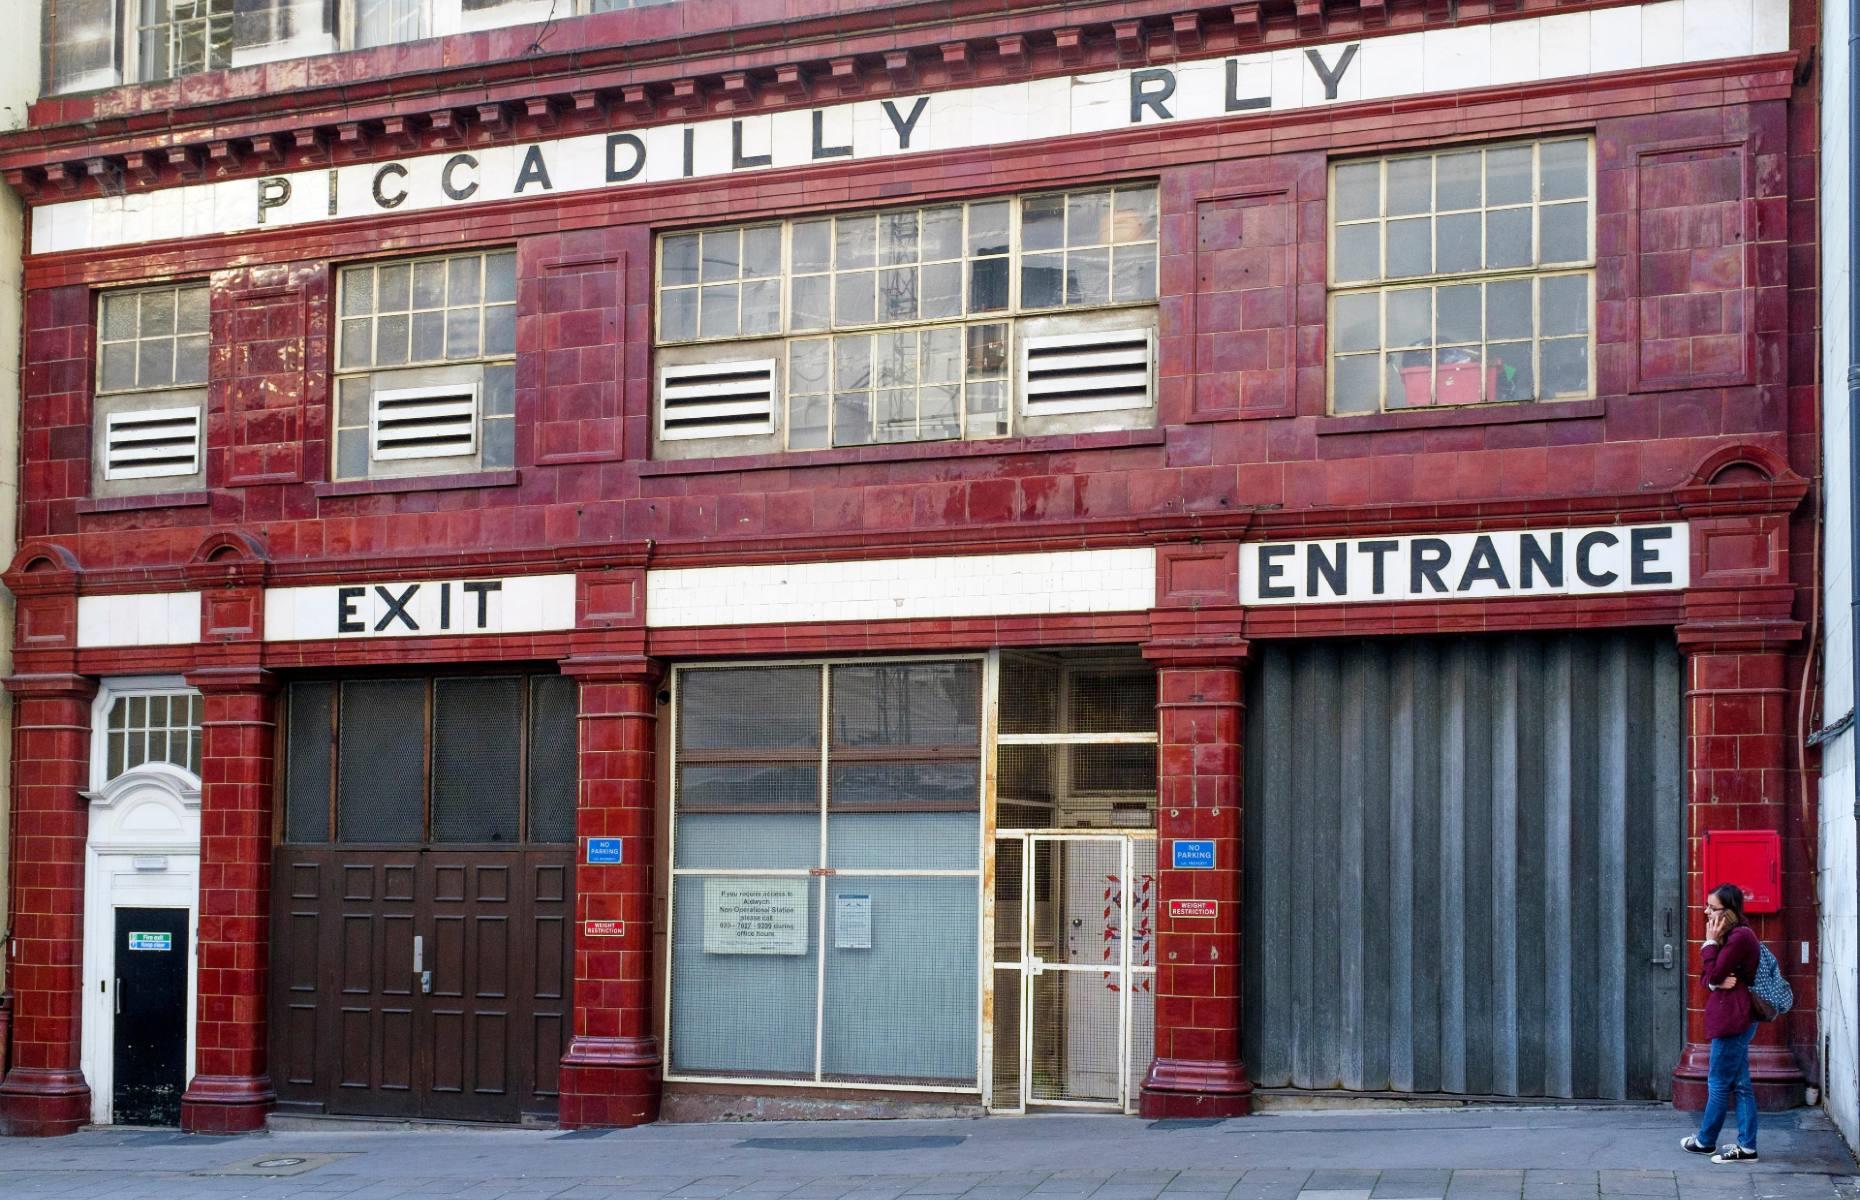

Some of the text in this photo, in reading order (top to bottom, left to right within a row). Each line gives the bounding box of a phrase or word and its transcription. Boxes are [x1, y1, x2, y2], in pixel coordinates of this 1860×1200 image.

[257, 43, 1360, 224] PICCADILLY RLY
[1257, 527, 1674, 601] ENTRANCE
[338, 581, 502, 633] EXIT
[1177, 851, 1212, 859] PARKING
